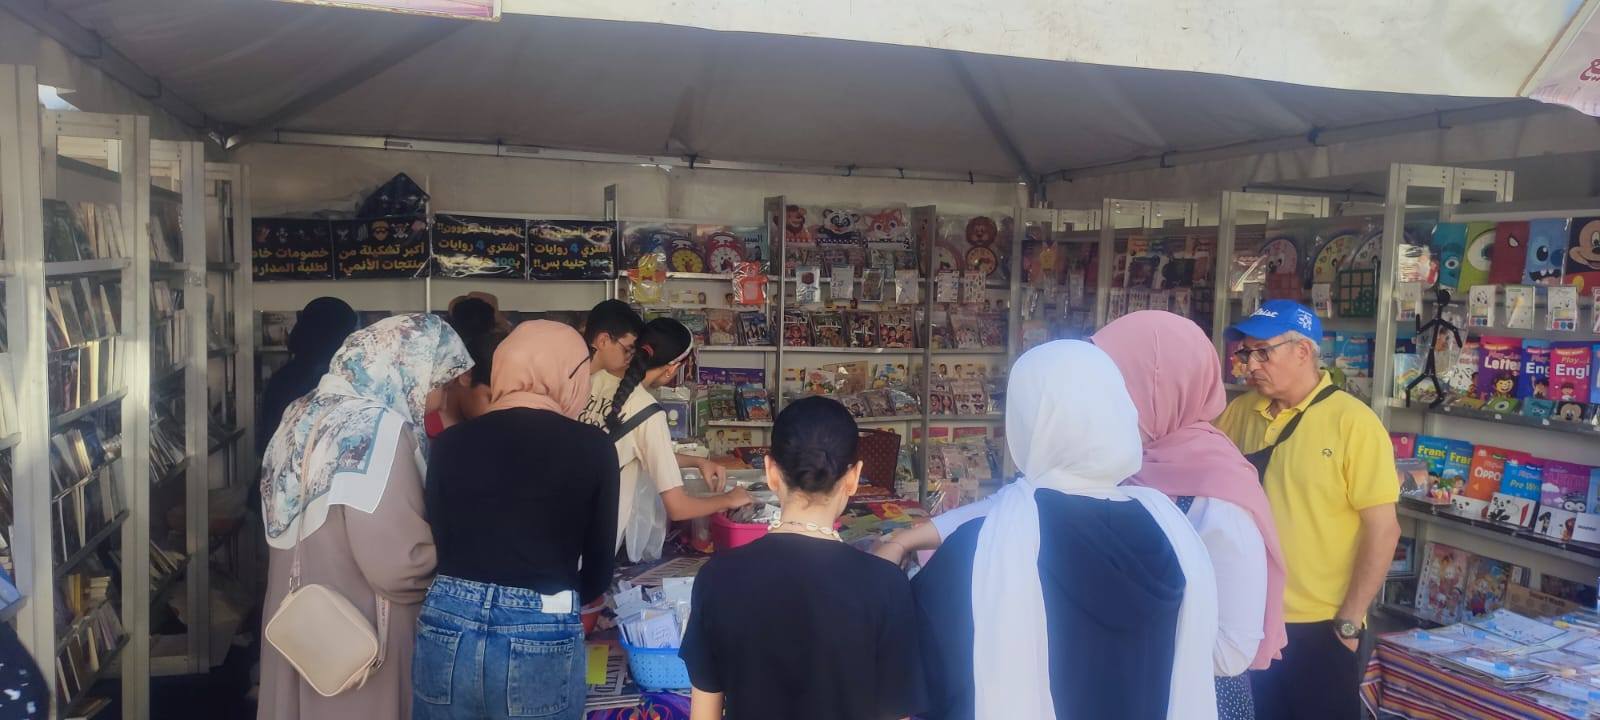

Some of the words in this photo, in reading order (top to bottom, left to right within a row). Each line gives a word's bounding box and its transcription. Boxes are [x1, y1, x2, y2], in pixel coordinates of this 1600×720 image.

[359, 243, 400, 257] تشكيلة
[402, 242, 424, 258] أكبر
[438, 239, 474, 252] روايات
[475, 240, 485, 250] 4
[534, 243, 568, 256] روايات
[569, 242, 579, 253] 4
[275, 247, 329, 260] خصومات
[338, 249, 357, 260] من
[382, 259, 424, 271] منتجات
[562, 258, 587, 270] جنيه
[1555, 363, 1590, 379] Engl
